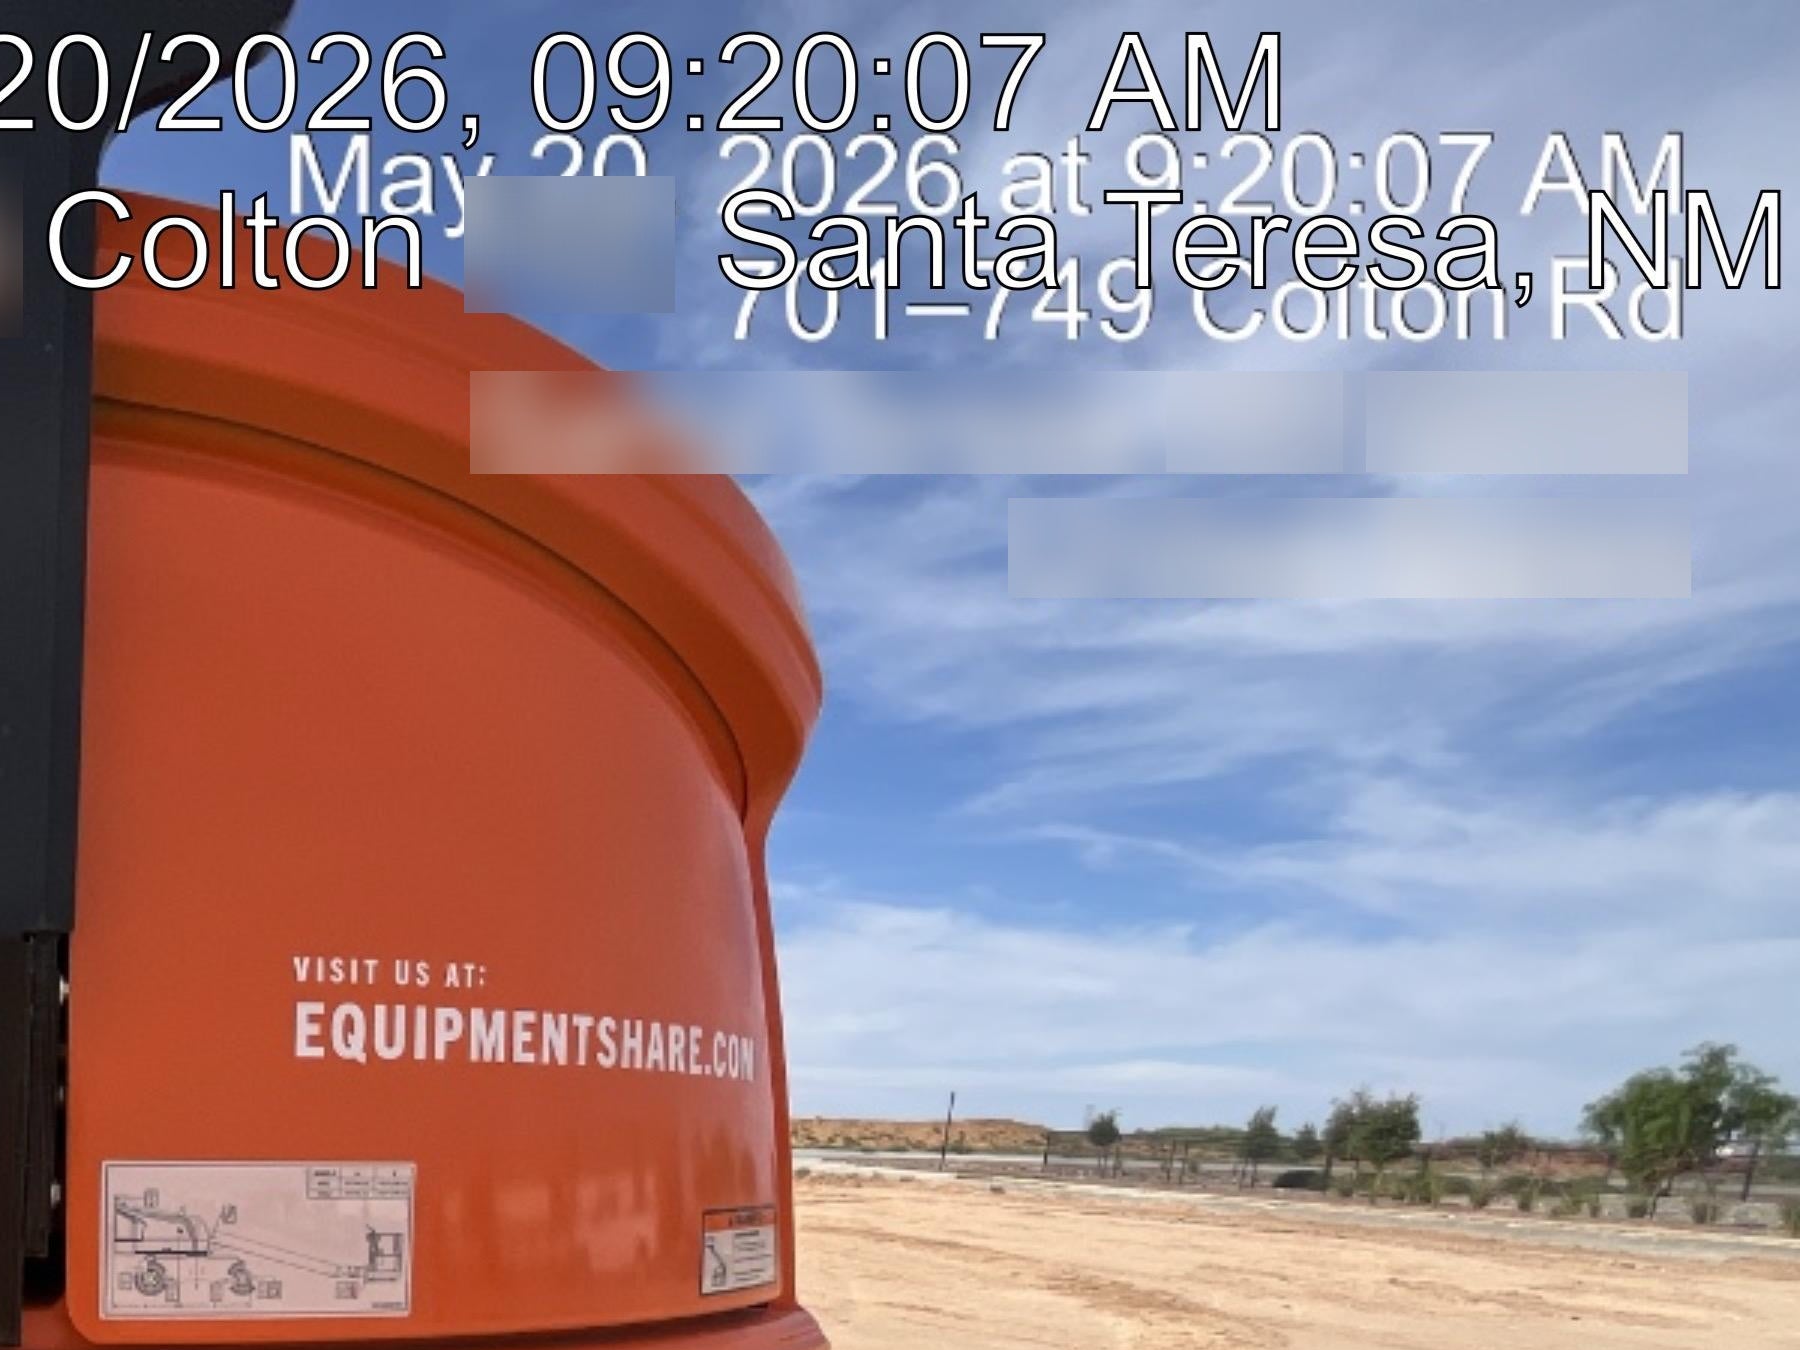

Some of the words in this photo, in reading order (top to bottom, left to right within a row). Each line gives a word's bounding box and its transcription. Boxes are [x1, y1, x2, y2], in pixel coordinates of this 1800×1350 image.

[293, 956, 378, 986] VISIT
[395, 958, 431, 987] US
[444, 963, 487, 988] AT:
[294, 1001, 755, 1083] EQUIPMENTSHARE.COM
